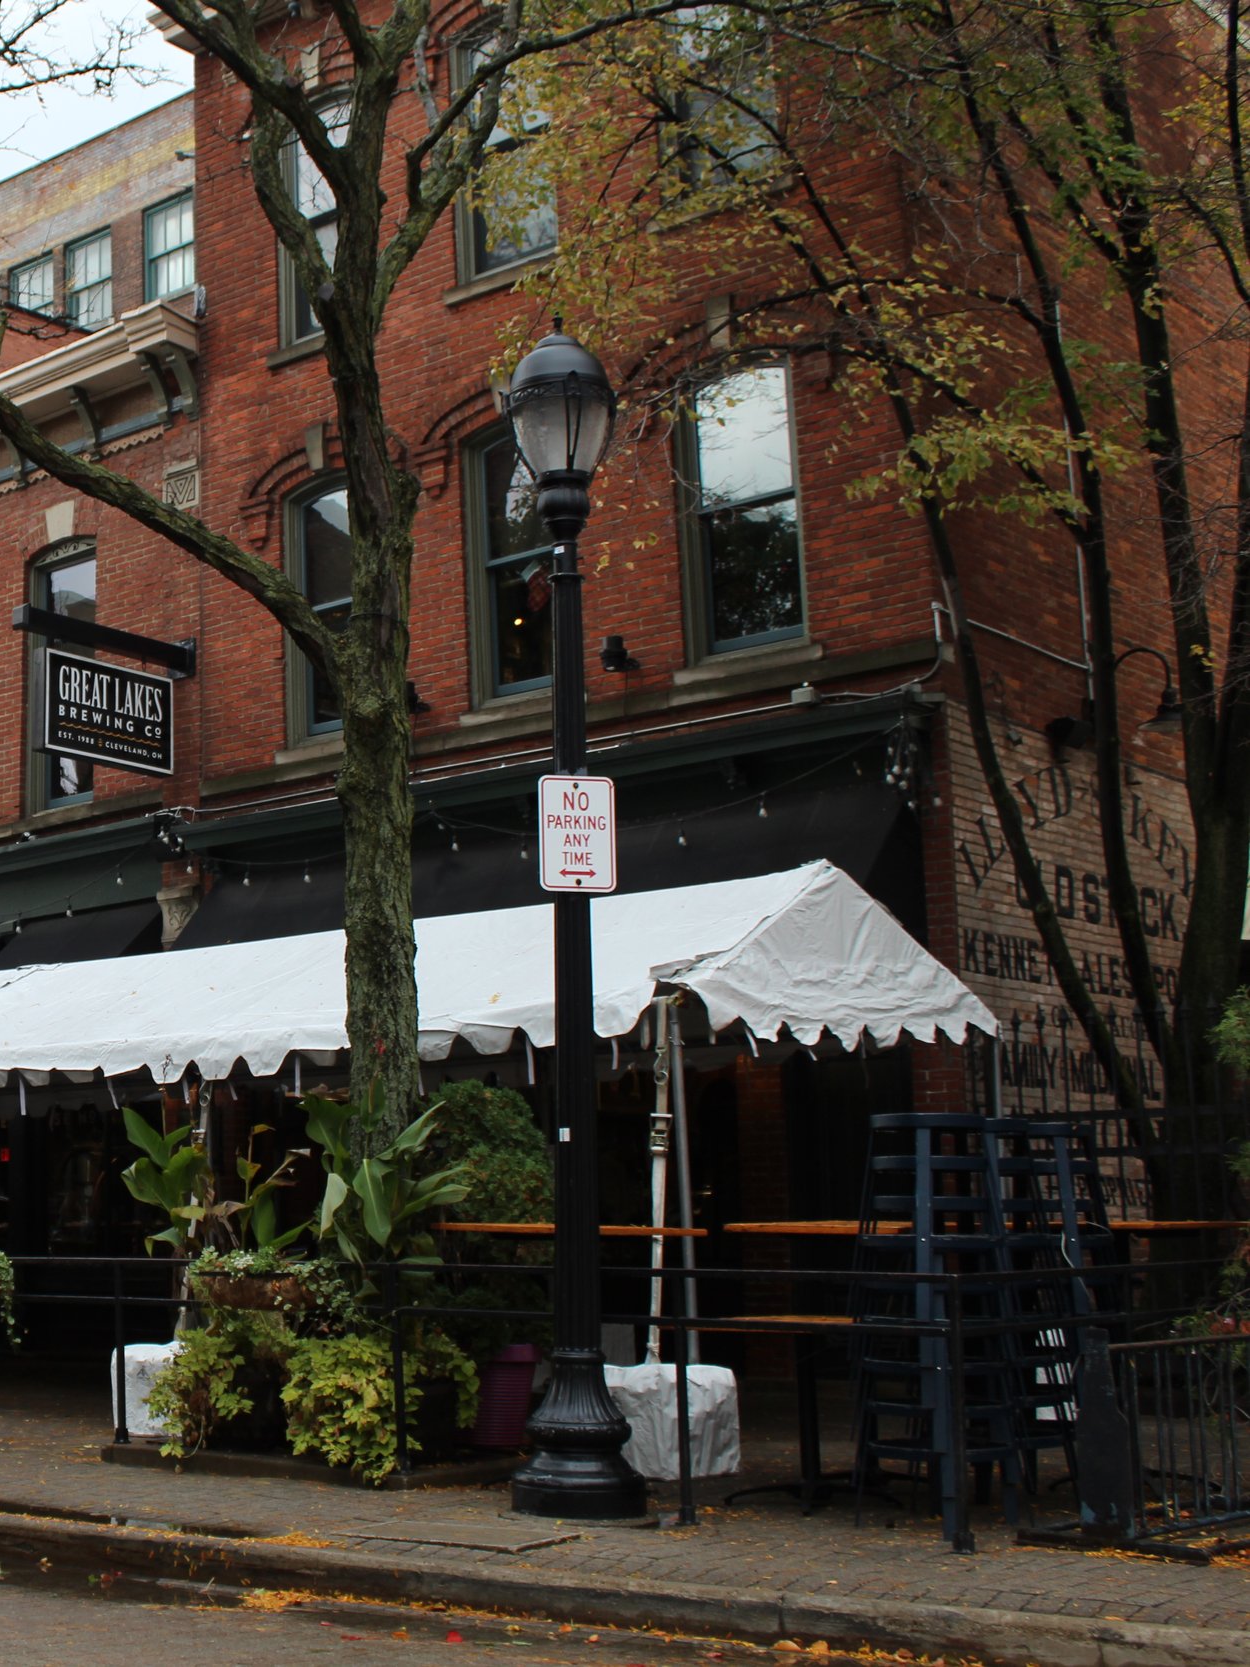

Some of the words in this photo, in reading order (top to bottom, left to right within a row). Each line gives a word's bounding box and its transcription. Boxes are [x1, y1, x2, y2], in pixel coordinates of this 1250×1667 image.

[59, 665, 110, 710] GREAT
[115, 678, 163, 722] LAKES
[58, 704, 134, 732] BREWING
[58, 731, 74, 741] EST.
[105, 741, 149, 758] CLEVELAND,
[152, 752, 163, 760] OH
[563, 792, 589, 811] NO
[547, 815, 606, 831] PARKING
[563, 834, 590, 847] ANY
[562, 852, 593, 866] TIME
